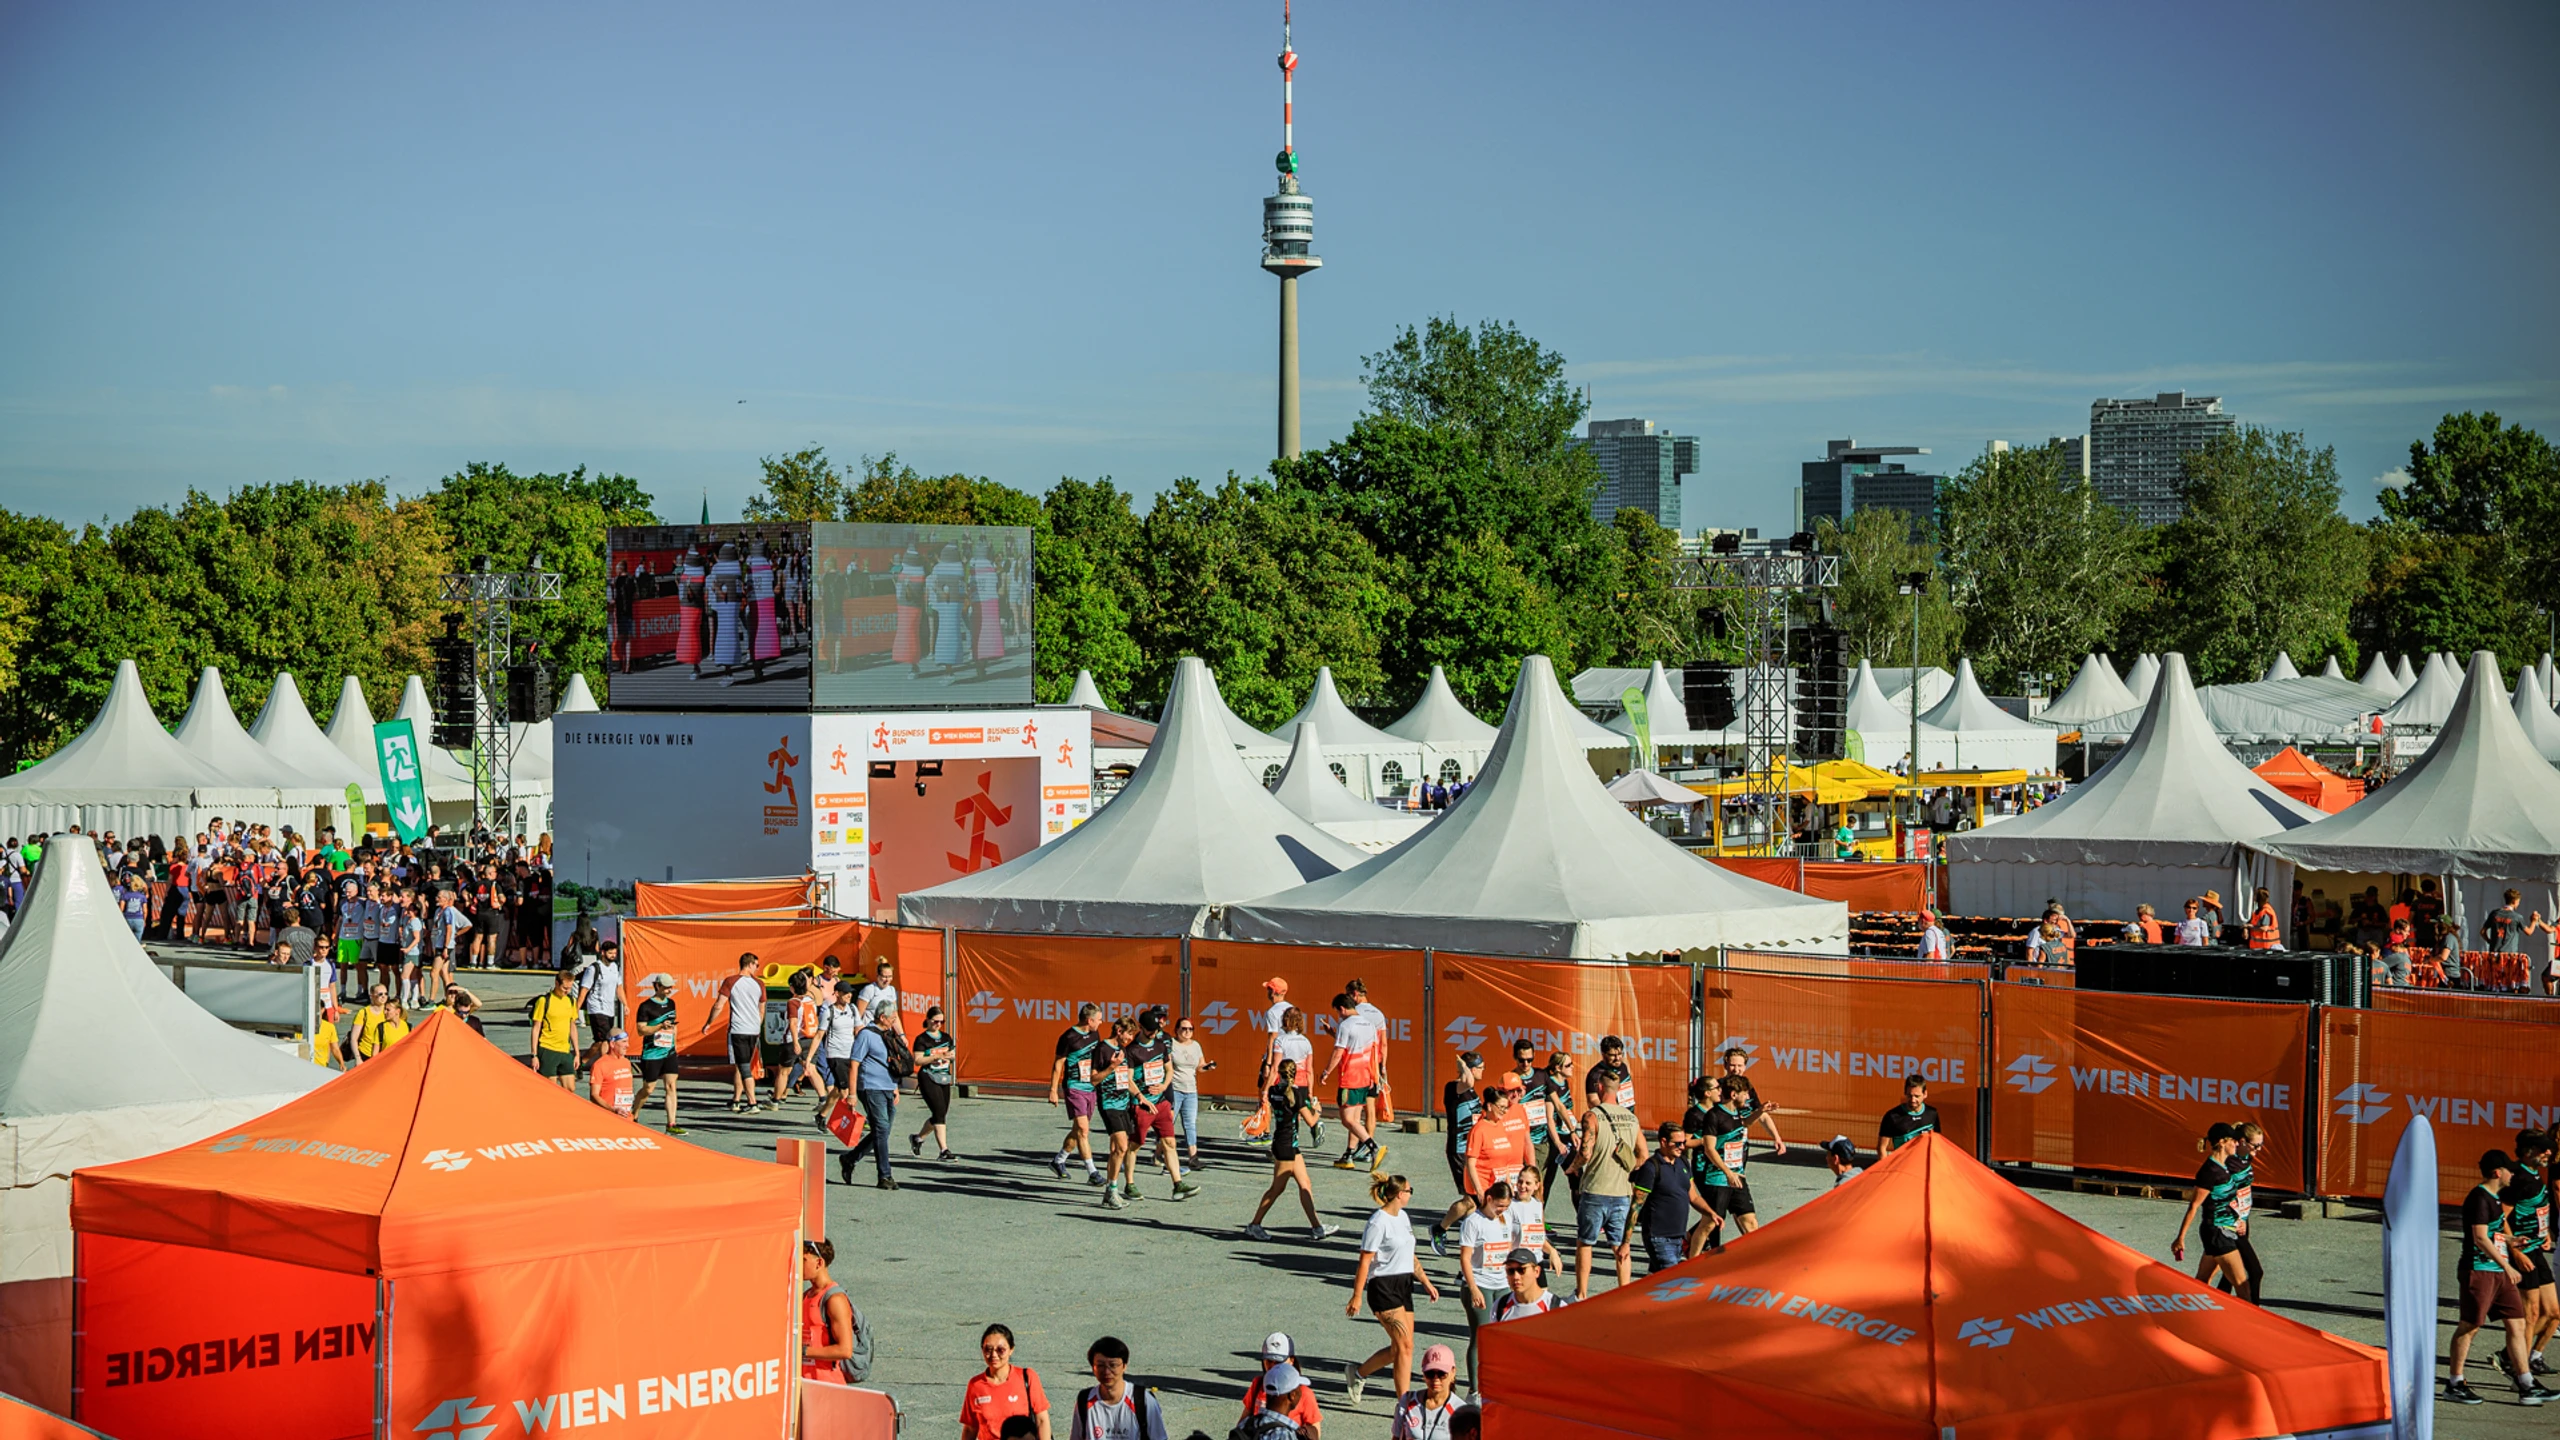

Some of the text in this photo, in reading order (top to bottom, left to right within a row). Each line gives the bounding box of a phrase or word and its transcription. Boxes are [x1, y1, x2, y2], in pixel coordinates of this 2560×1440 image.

[565, 732, 694, 746] DIE ENERGIE VON WIEN
[892, 728, 925, 737] BUSINESS
[892, 737, 907, 745] RUN
[943, 732, 981, 740] WIEN ENERGIE
[987, 726, 1020, 735] BUSINESS
[987, 735, 1001, 743] RUN
[764, 818, 798, 826] BUSINESS
[764, 827, 779, 835] RUN
[1012, 998, 1070, 1021] WIEN
[1571, 1032, 1678, 1062] ENRGIE
[1770, 1046, 1965, 1084] WIEN ENERGIE
[2069, 1066, 2290, 1110] WIEN ENERGIE
[2406, 1094, 2495, 1127] WIEN
[250, 1137, 391, 1168] WIEN ENERGIE
[476, 1137, 661, 1162] WIEN ENERGIE
[1708, 1283, 1916, 1346] WIEN ENERGIE
[2016, 1293, 2225, 1331] WIEN ENERGIE
[512, 1358, 780, 1435] WIEN ENERGIE
